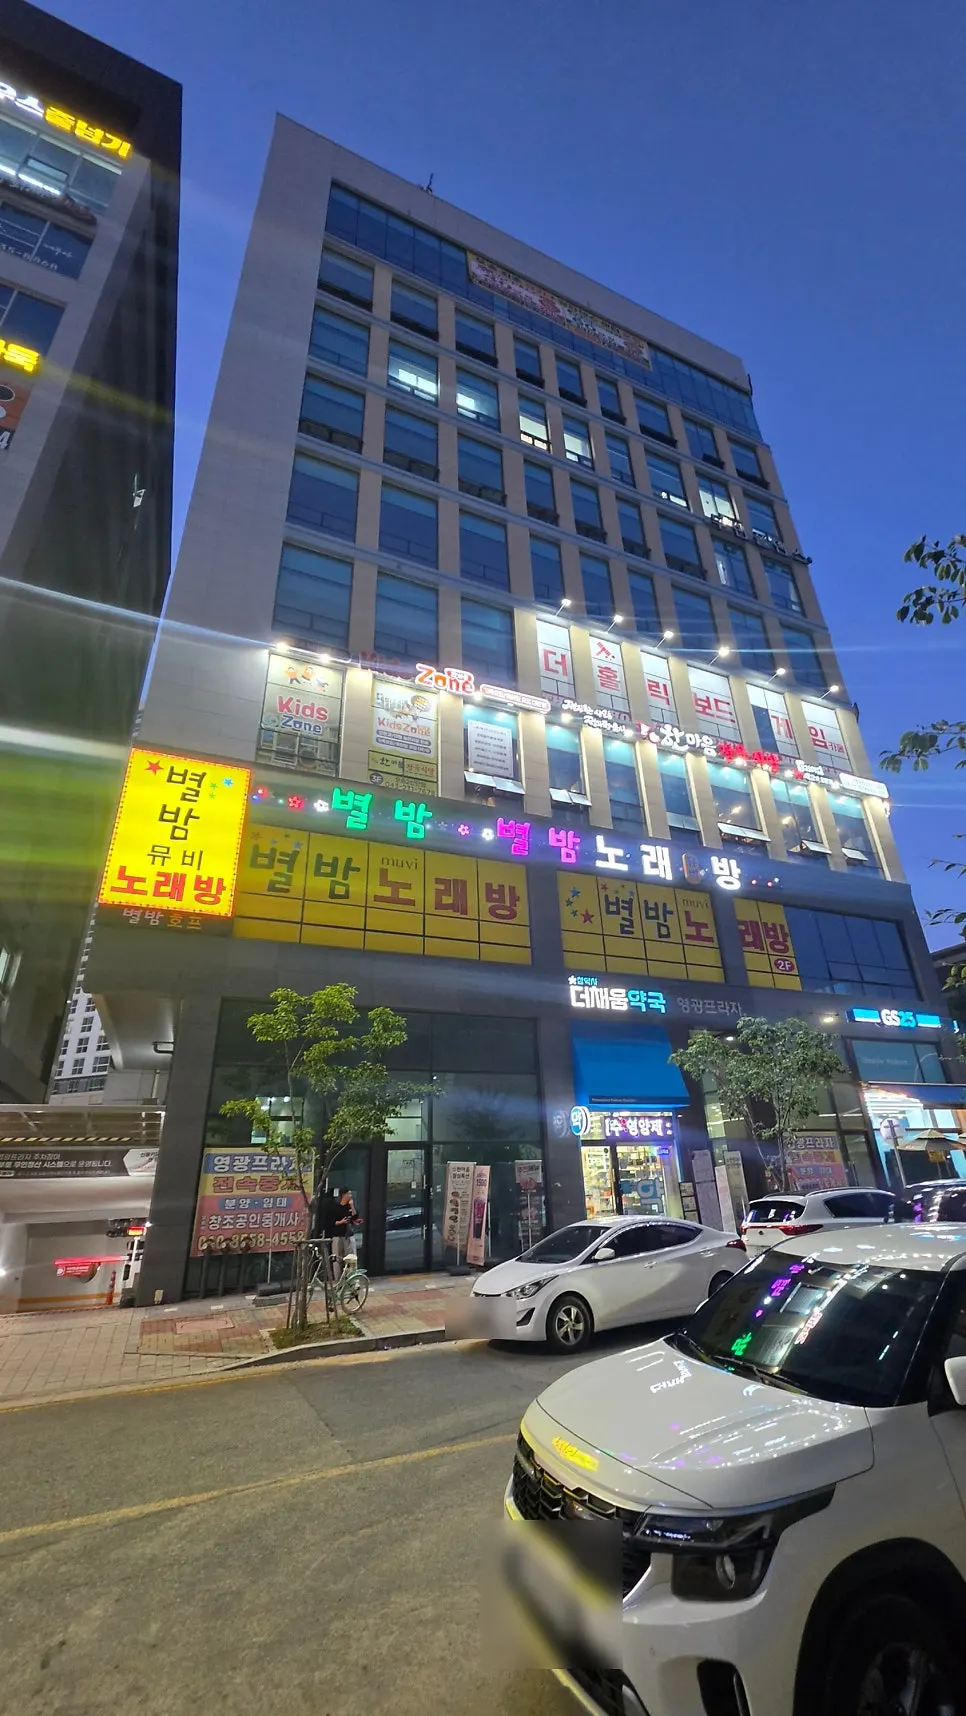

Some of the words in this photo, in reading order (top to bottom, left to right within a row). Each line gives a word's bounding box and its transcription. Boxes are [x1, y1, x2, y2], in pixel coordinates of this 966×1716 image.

[277, 695, 328, 721] Kids
[281, 714, 322, 735] Zone
[660, 724, 717, 757] 한마음
[110, 865, 227, 905] 노래방
[777, 960, 793, 971] 2F
[569, 985, 666, 1014] 더채움약국
[676, 997, 743, 1017] 영광프라자
[880, 1008, 917, 1028] GS25
[208, 1211, 299, 1231] 창조공인중개사
